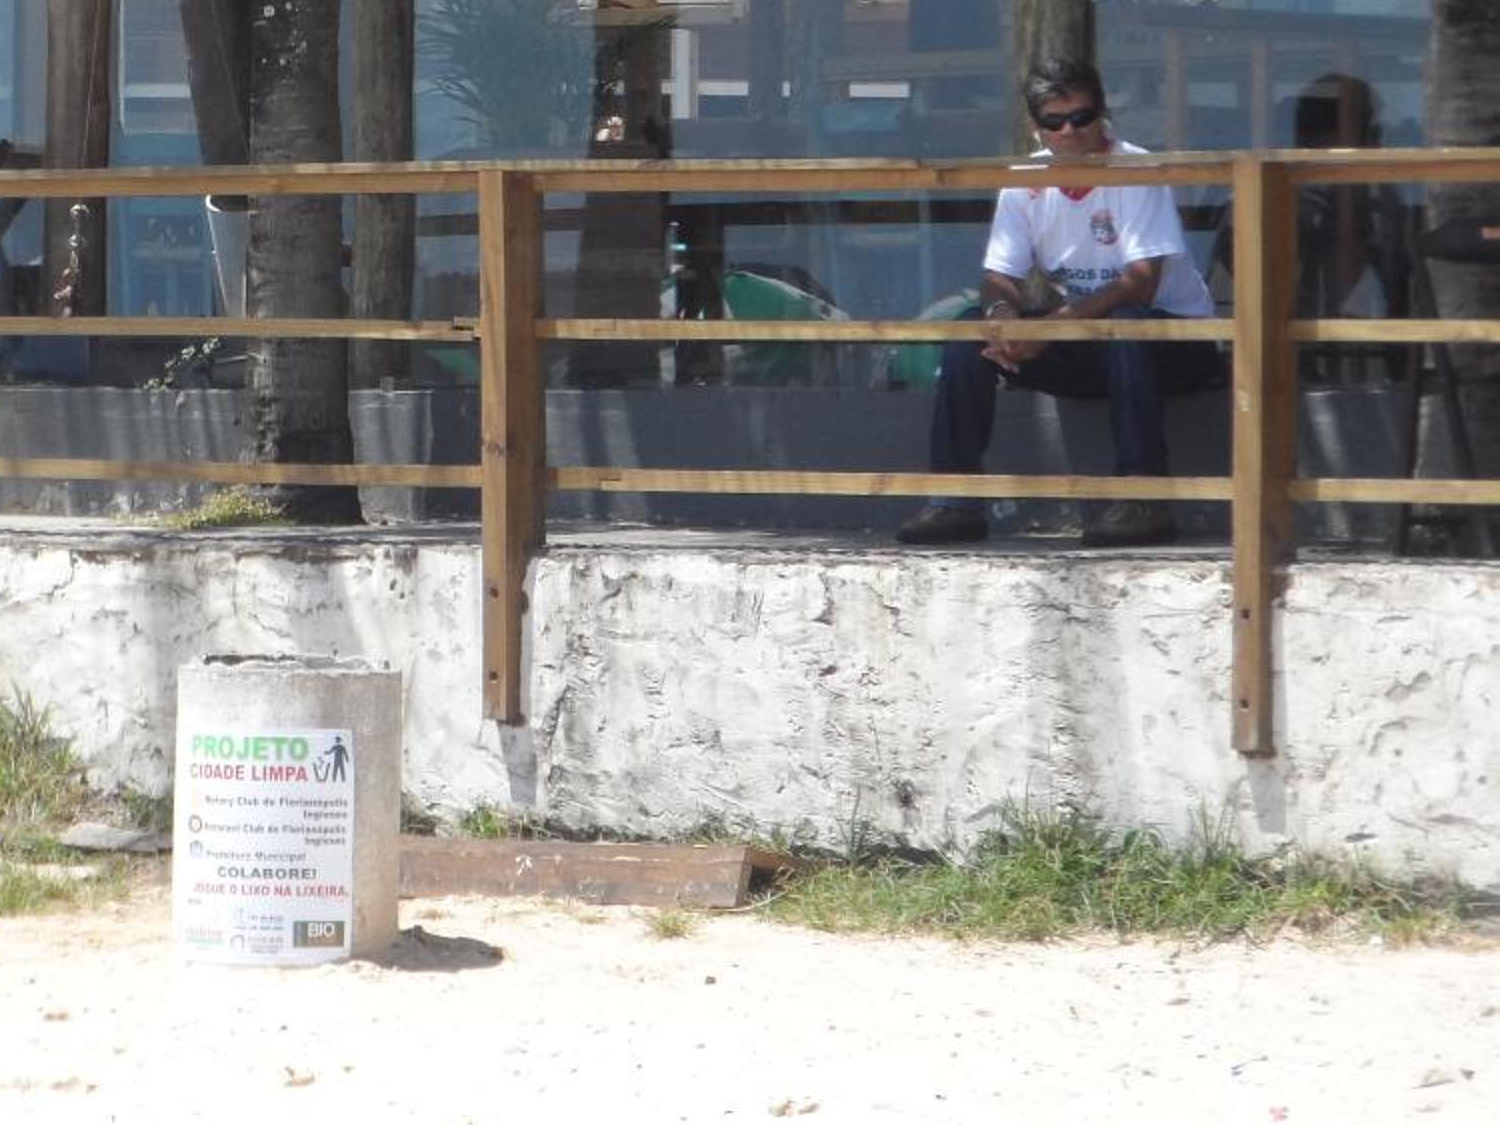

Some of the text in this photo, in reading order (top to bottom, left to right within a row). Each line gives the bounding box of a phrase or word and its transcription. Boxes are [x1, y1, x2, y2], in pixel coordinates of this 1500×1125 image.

[192, 735, 310, 762] PROJETO
[189, 762, 309, 782] CIDADE LIMPA
[217, 866, 317, 880] COLABORE!
[241, 884, 271, 896] LIXO
[273, 885, 293, 897] NA
[308, 922, 335, 938] BIO
